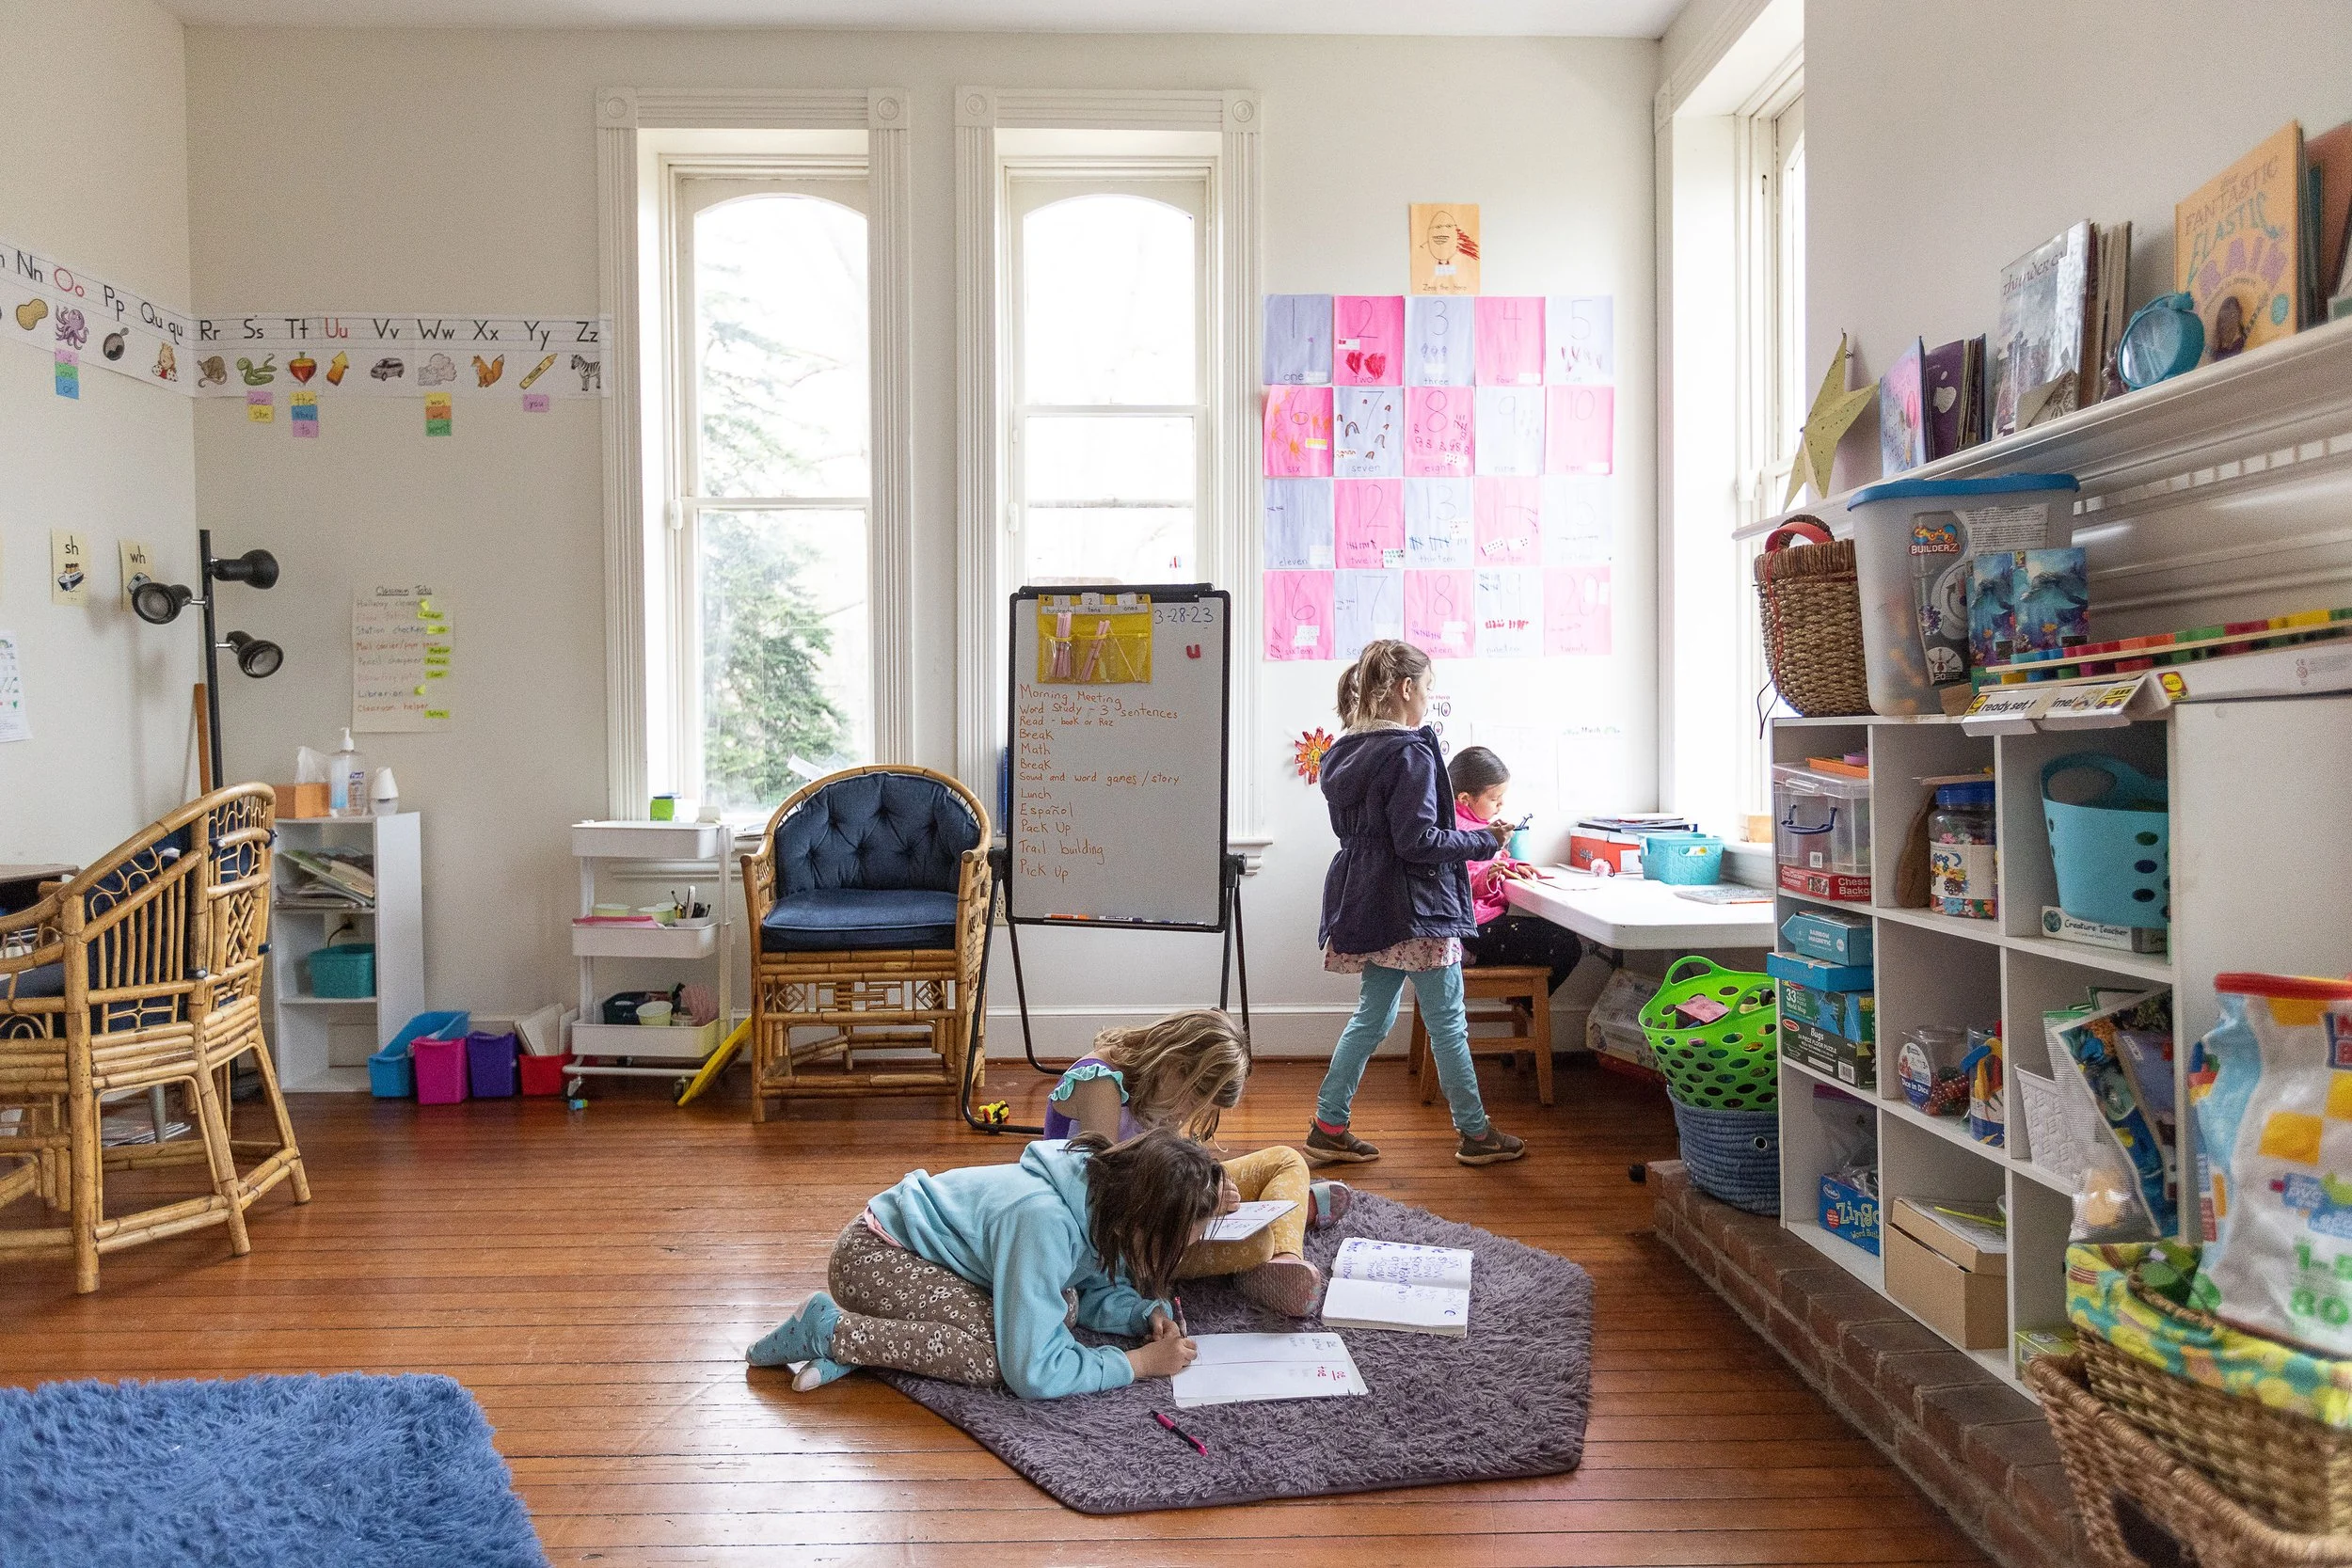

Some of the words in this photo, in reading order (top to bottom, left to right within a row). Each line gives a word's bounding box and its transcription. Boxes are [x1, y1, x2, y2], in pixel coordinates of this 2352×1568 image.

[2185, 153, 2279, 237] FANTASTIC
[17, 249, 43, 283] Nn
[54, 267, 85, 297] Oo
[103, 284, 125, 322] Pp
[141, 301, 164, 329] Qu
[167, 321, 183, 345] qu
[1355, 299, 1378, 339] 2
[1432, 299, 1450, 336] 3
[1502, 301, 1523, 340] 4
[1570, 299, 1593, 341] 5
[199, 320, 221, 341] Rr
[243, 318, 264, 340] Ss
[284, 318, 310, 339] Tt
[325, 317, 348, 339] Uu
[373, 318, 400, 339] Vv
[417, 319, 455, 340] Ww
[472, 320, 500, 341] Xx
[523, 321, 550, 351] Yy
[575, 321, 598, 342] Zz
[1283, 371, 1305, 382] one
[1422, 376, 1450, 386] three
[1289, 389, 1309, 425] 6
[1359, 390, 1386, 429] 7
[1424, 389, 1448, 433] 8
[1570, 389, 1596, 421] 10
[1498, 395, 1517, 435] 9
[1286, 464, 1301, 474] six
[1351, 464, 1381, 473] seven
[1423, 463, 1452, 474] eight
[1286, 484, 1306, 527] 11
[1357, 483, 1389, 528] 12
[1425, 484, 1457, 520] 13
[65, 535, 79, 555] sh
[1911, 543, 1958, 554] BUILDERZ
[130, 546, 146, 564] wh
[1278, 556, 1308, 566] eleven
[1283, 574, 1316, 621] 16
[1355, 575, 1389, 621] 17
[1425, 574, 1454, 616] 18
[1154, 606, 1215, 625] 3-28-23
[1020, 683, 1069, 705] Morning
[1077, 690, 1122, 710] Meeting
[2052, 696, 2079, 708] ime!
[1019, 705, 1044, 715] Word
[1053, 703, 1082, 716] Study
[1099, 705, 1109, 716] 3
[1120, 703, 1179, 720] sentences
[1433, 702, 1451, 717] 40
[1020, 716, 1044, 726] Read
[1060, 717, 1079, 726] book
[1020, 729, 1055, 740] Break
[1021, 742, 1051, 755] Math
[1020, 757, 1052, 769] Break
[1020, 771, 1043, 781] Sound
[1049, 772, 1065, 782] and
[1073, 772, 1097, 783] word
[1106, 775, 1137, 786] games
[1021, 786, 1052, 800] Lunch
[1020, 801, 1073, 819] Español
[1021, 819, 1049, 833] Pack
[1056, 821, 1071, 836] Up
[1019, 839, 1046, 854] Trail
[1059, 838, 1104, 865] building
[1020, 858, 1046, 877] Pick
[1055, 866, 1069, 883] Up
[1838, 886, 1871, 895] Backg
[1786, 988, 1797, 1004] 33
[1810, 1027, 1824, 1041] Bugs
